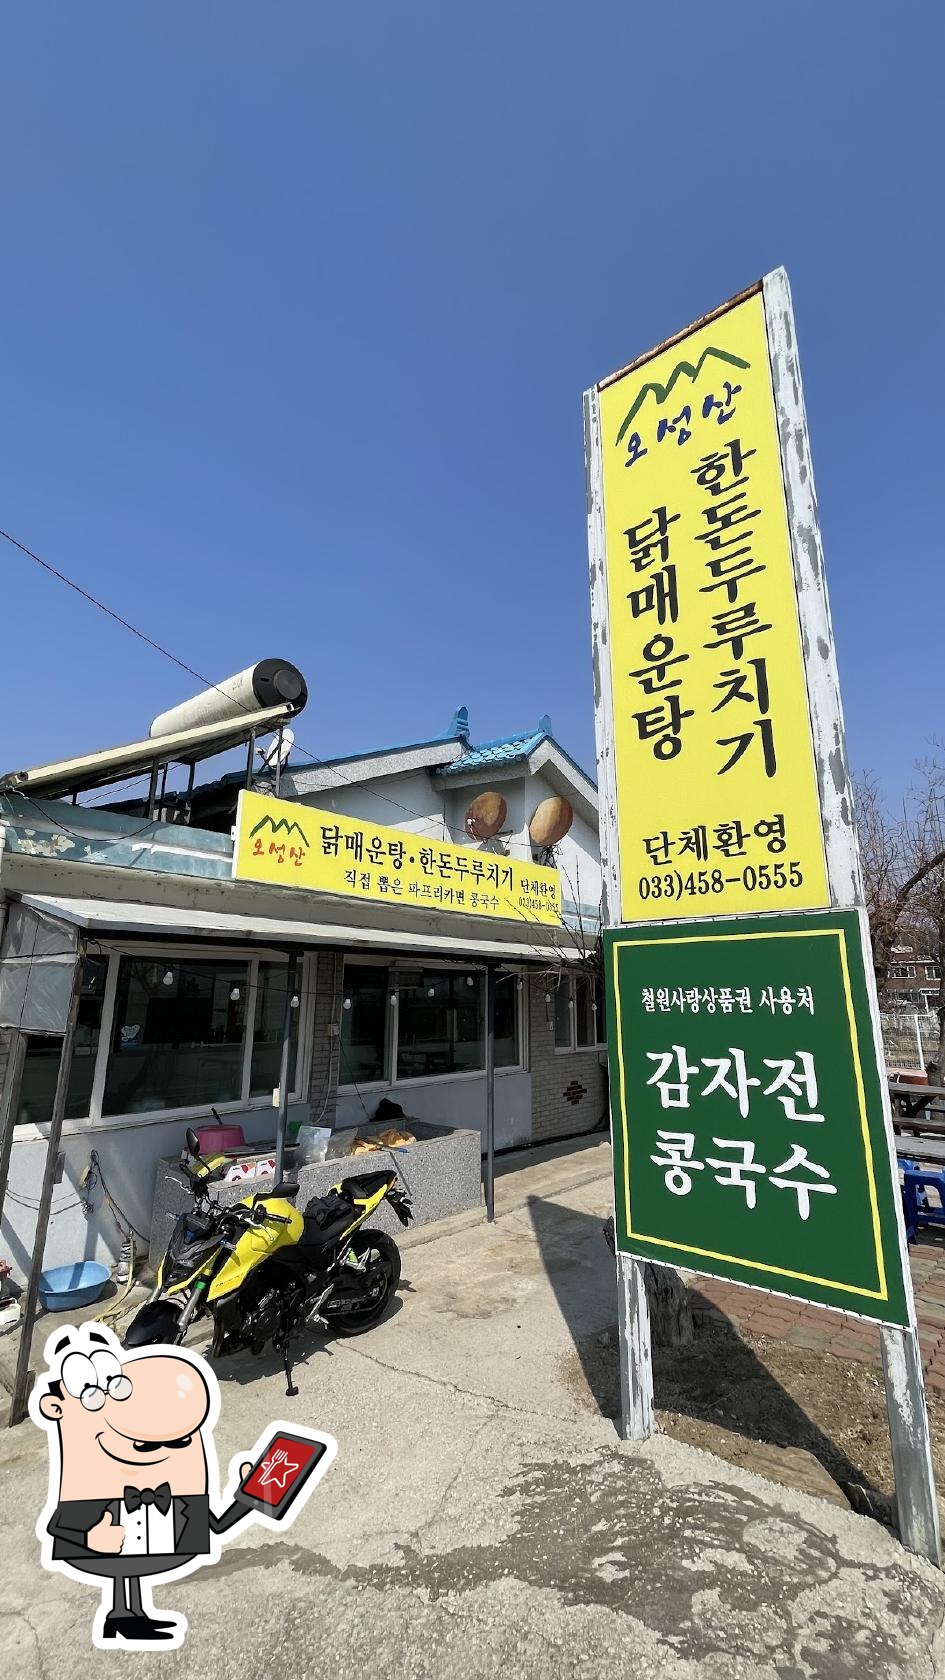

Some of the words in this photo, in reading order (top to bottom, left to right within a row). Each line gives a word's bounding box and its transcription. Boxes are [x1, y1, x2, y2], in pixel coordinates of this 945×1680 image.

[623, 382, 742, 468] 오성산
[622, 506, 695, 761] 닭매운탕
[252, 838, 306, 867] 오성산
[642, 813, 788, 866] 단체환영
[344, 869, 371, 890] 직접
[377, 875, 404, 895] 뽑은
[408, 881, 465, 905] 파프리카면
[470, 892, 500, 910] 콩국수
[520, 878, 556, 900] 단체환영
[638, 860, 803, 902] 033)458-0555
[641, 987, 753, 1014] 철원사랑상품권
[758, 985, 815, 1016] 사용처
[645, 1045, 826, 1123] 감자전
[649, 1129, 838, 1221] 콩국수
